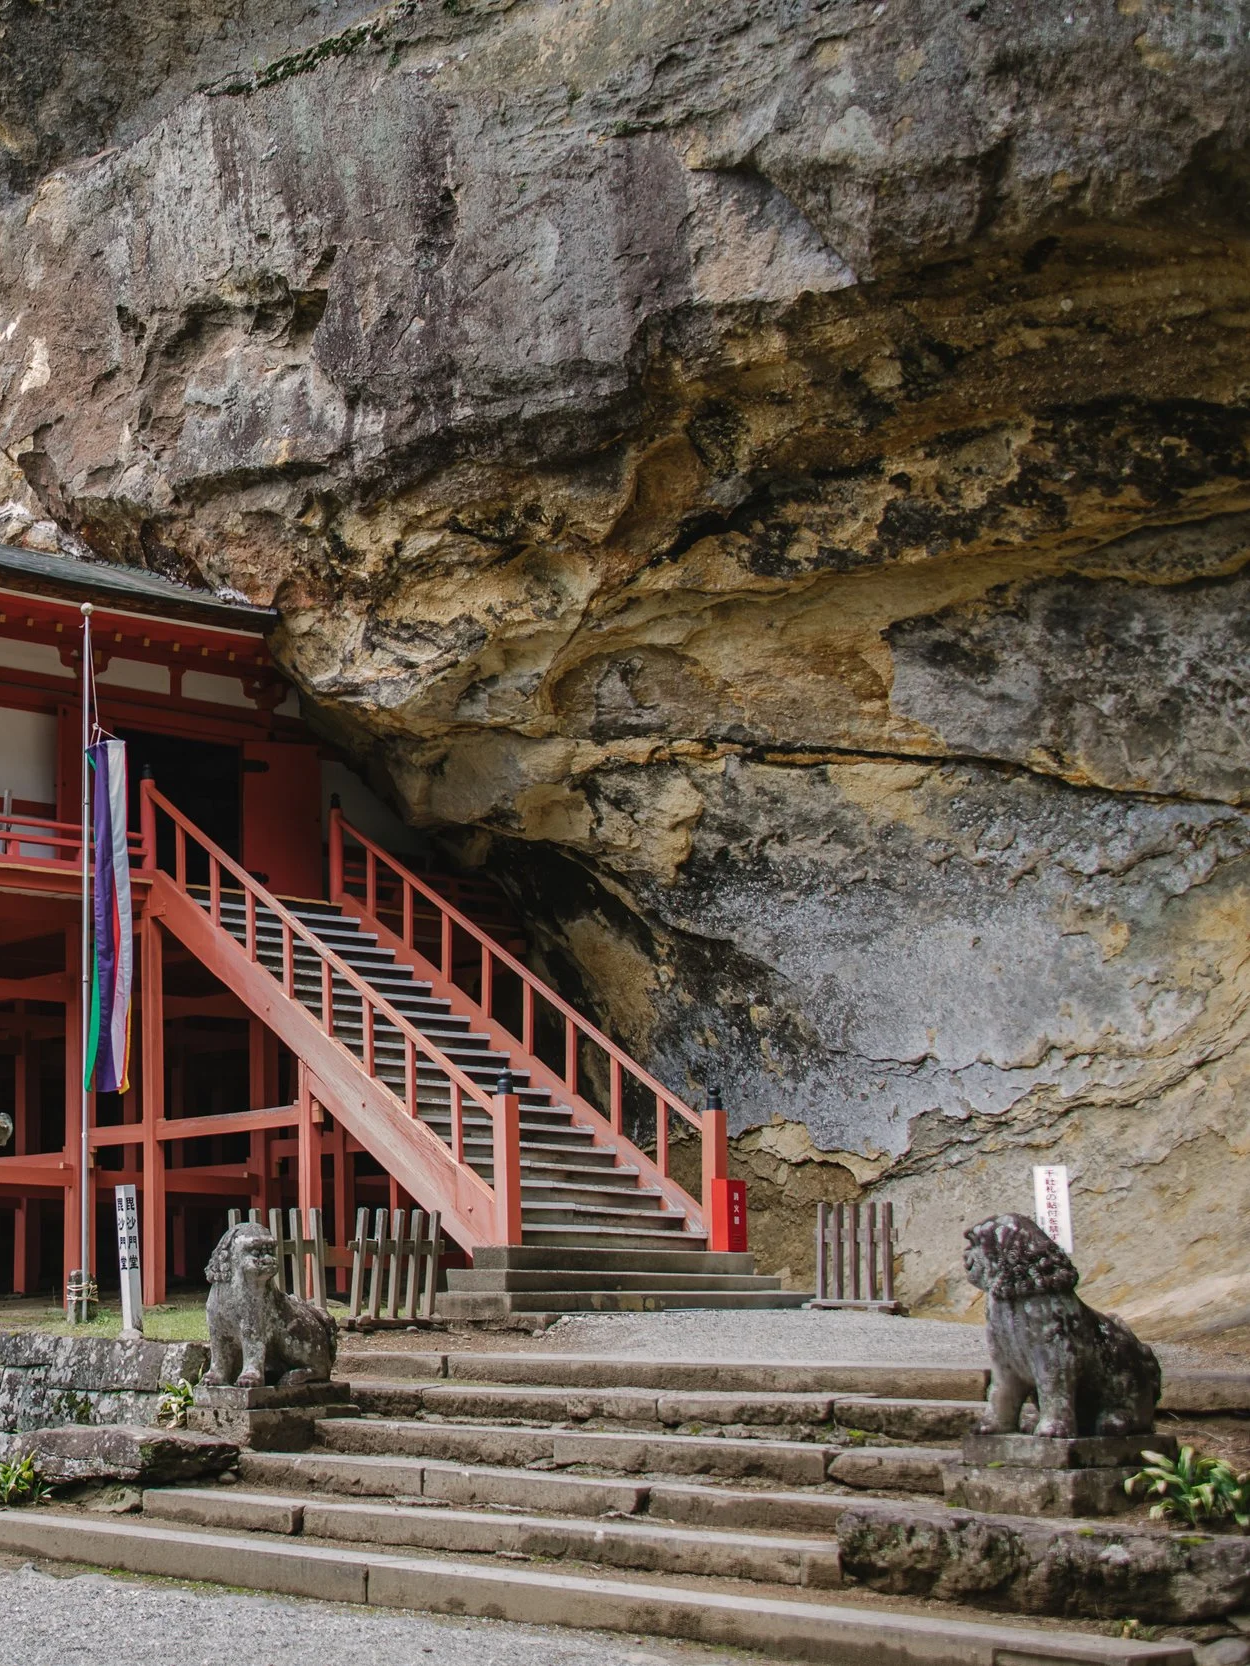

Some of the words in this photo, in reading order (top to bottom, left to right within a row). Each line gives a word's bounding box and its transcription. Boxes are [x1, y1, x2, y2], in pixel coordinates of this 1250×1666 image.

[117, 1198, 128, 1271] 毘沙門堂
[126, 1196, 139, 1270] 毘沙門堂
